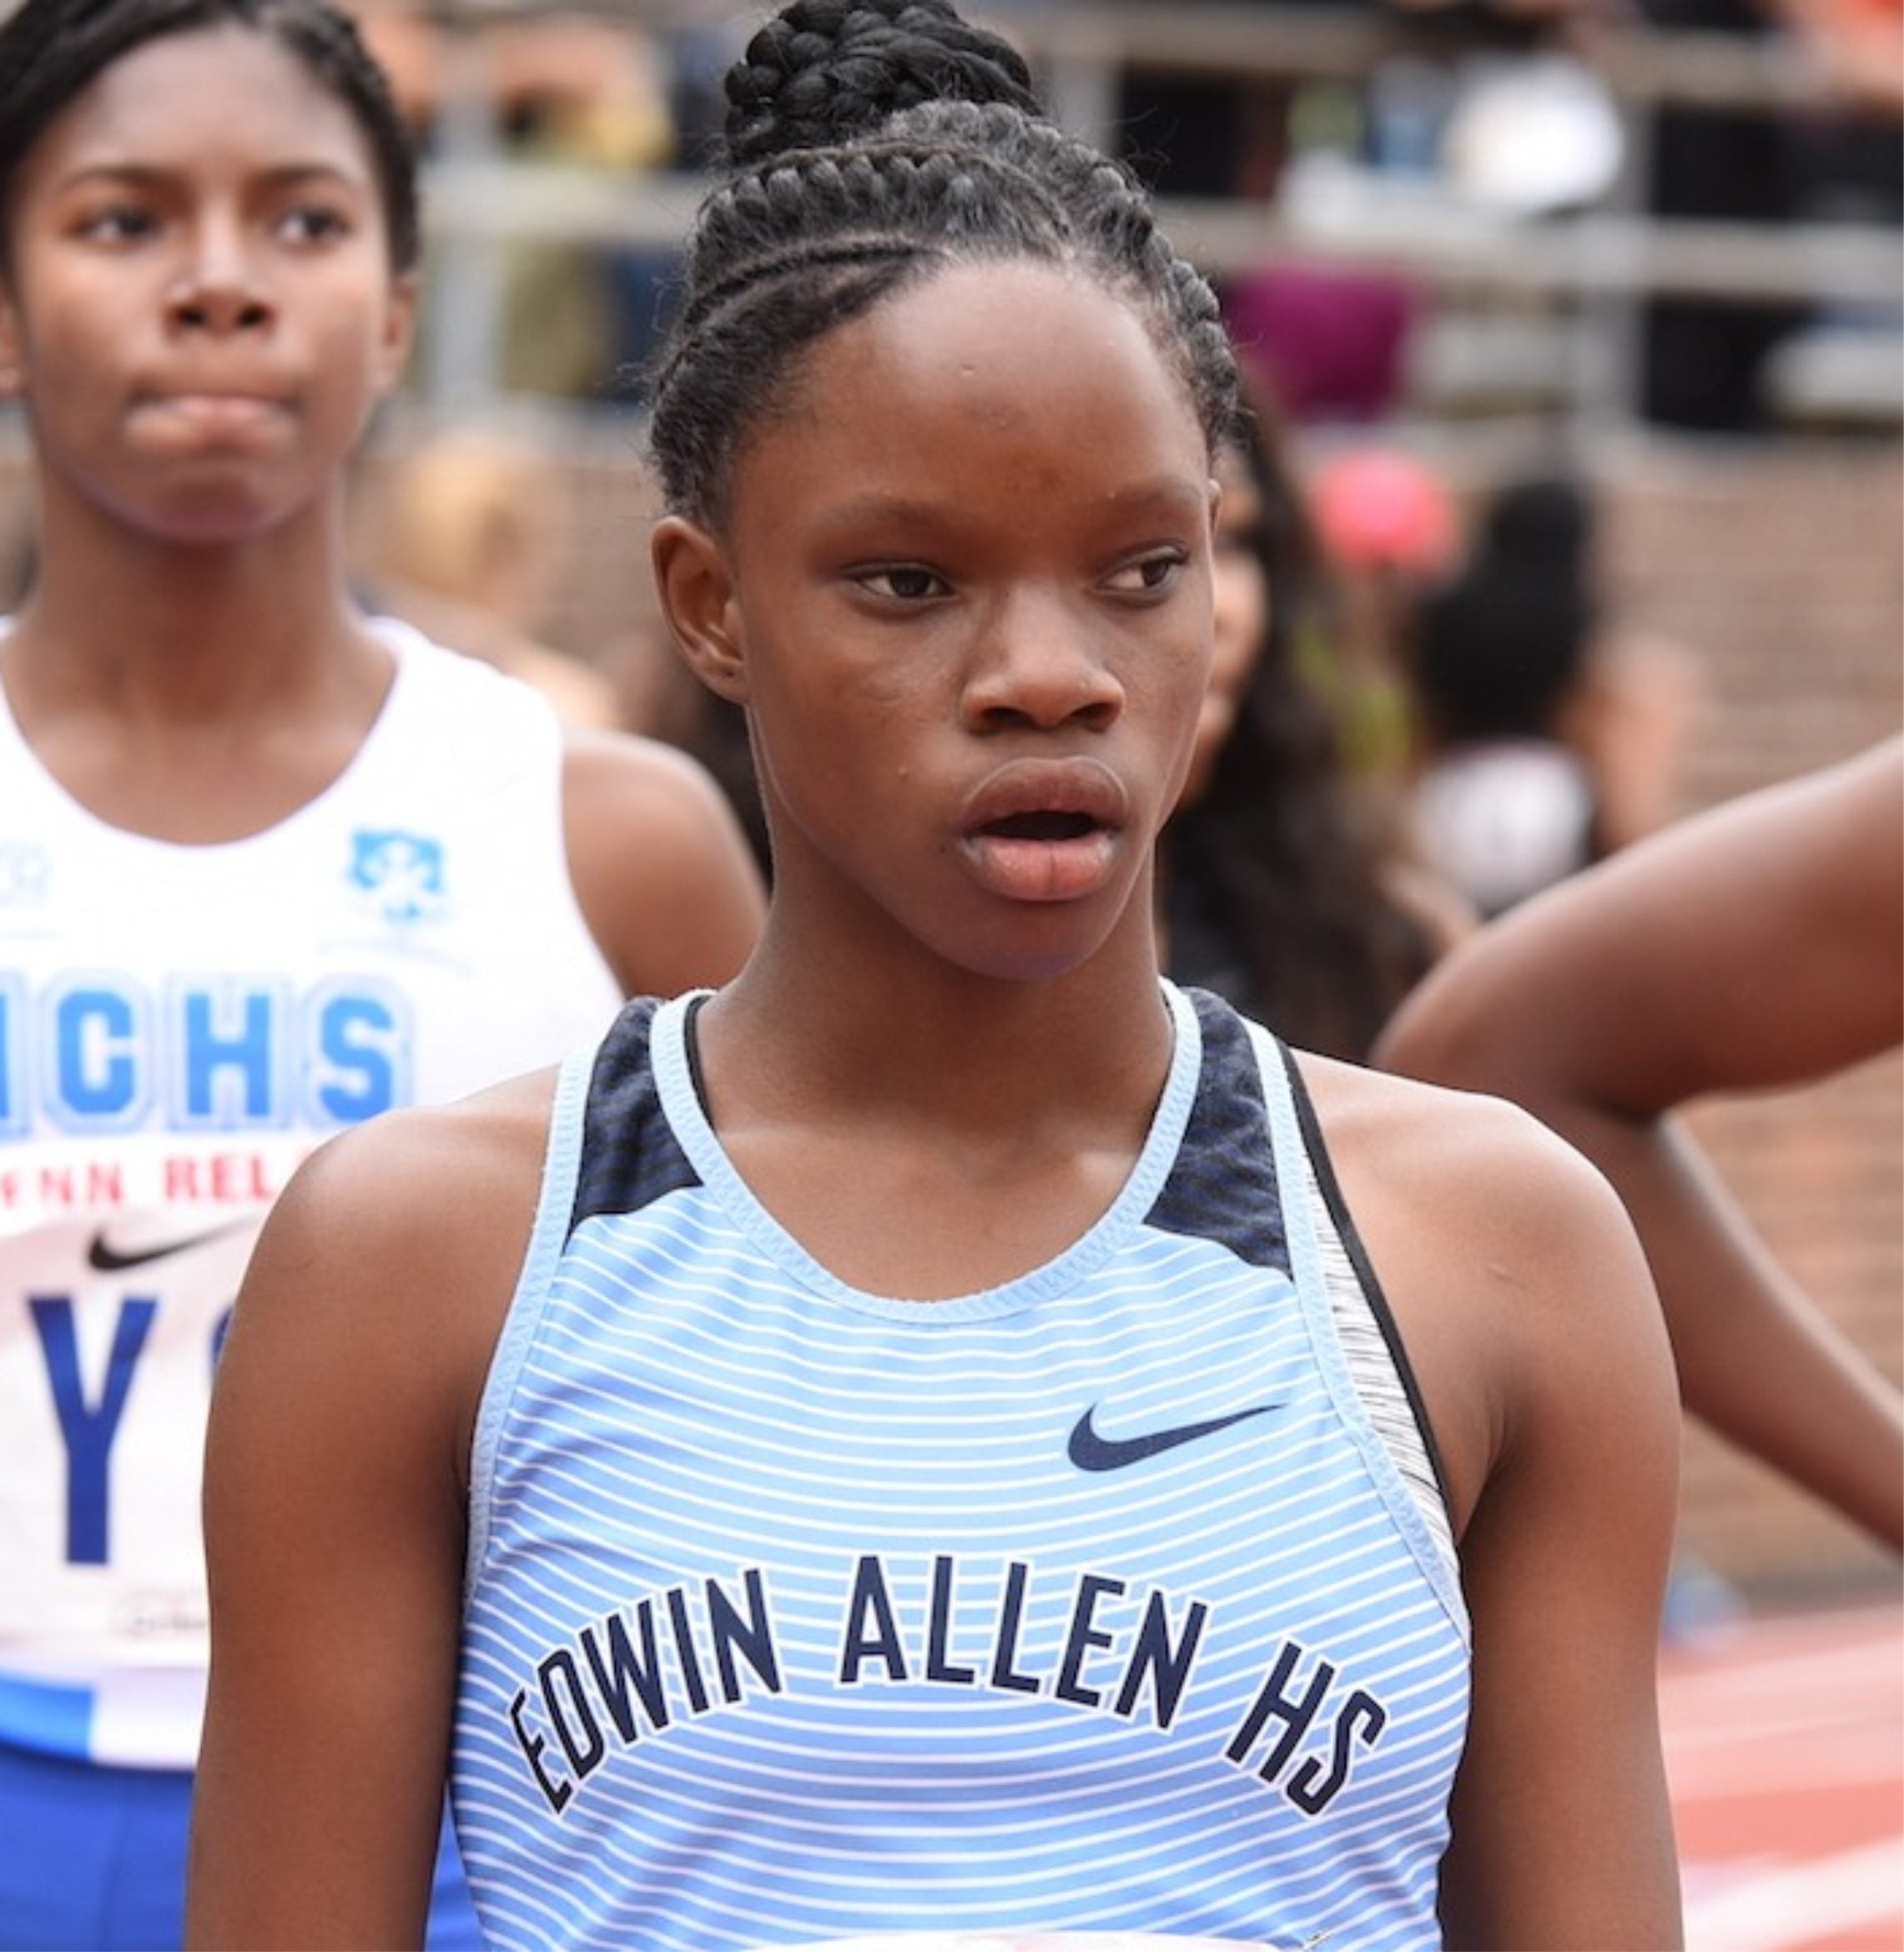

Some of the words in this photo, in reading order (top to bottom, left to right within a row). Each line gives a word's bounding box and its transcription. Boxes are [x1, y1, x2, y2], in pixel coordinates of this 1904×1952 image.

[0, 984, 397, 1124] CHS
[164, 1153, 314, 1201] REL
[28, 1295, 234, 1565] Y
[510, 1568, 783, 1814] EDWIN
[839, 1555, 1208, 1730] ALLEN
[1225, 1640, 1386, 1816] HS
